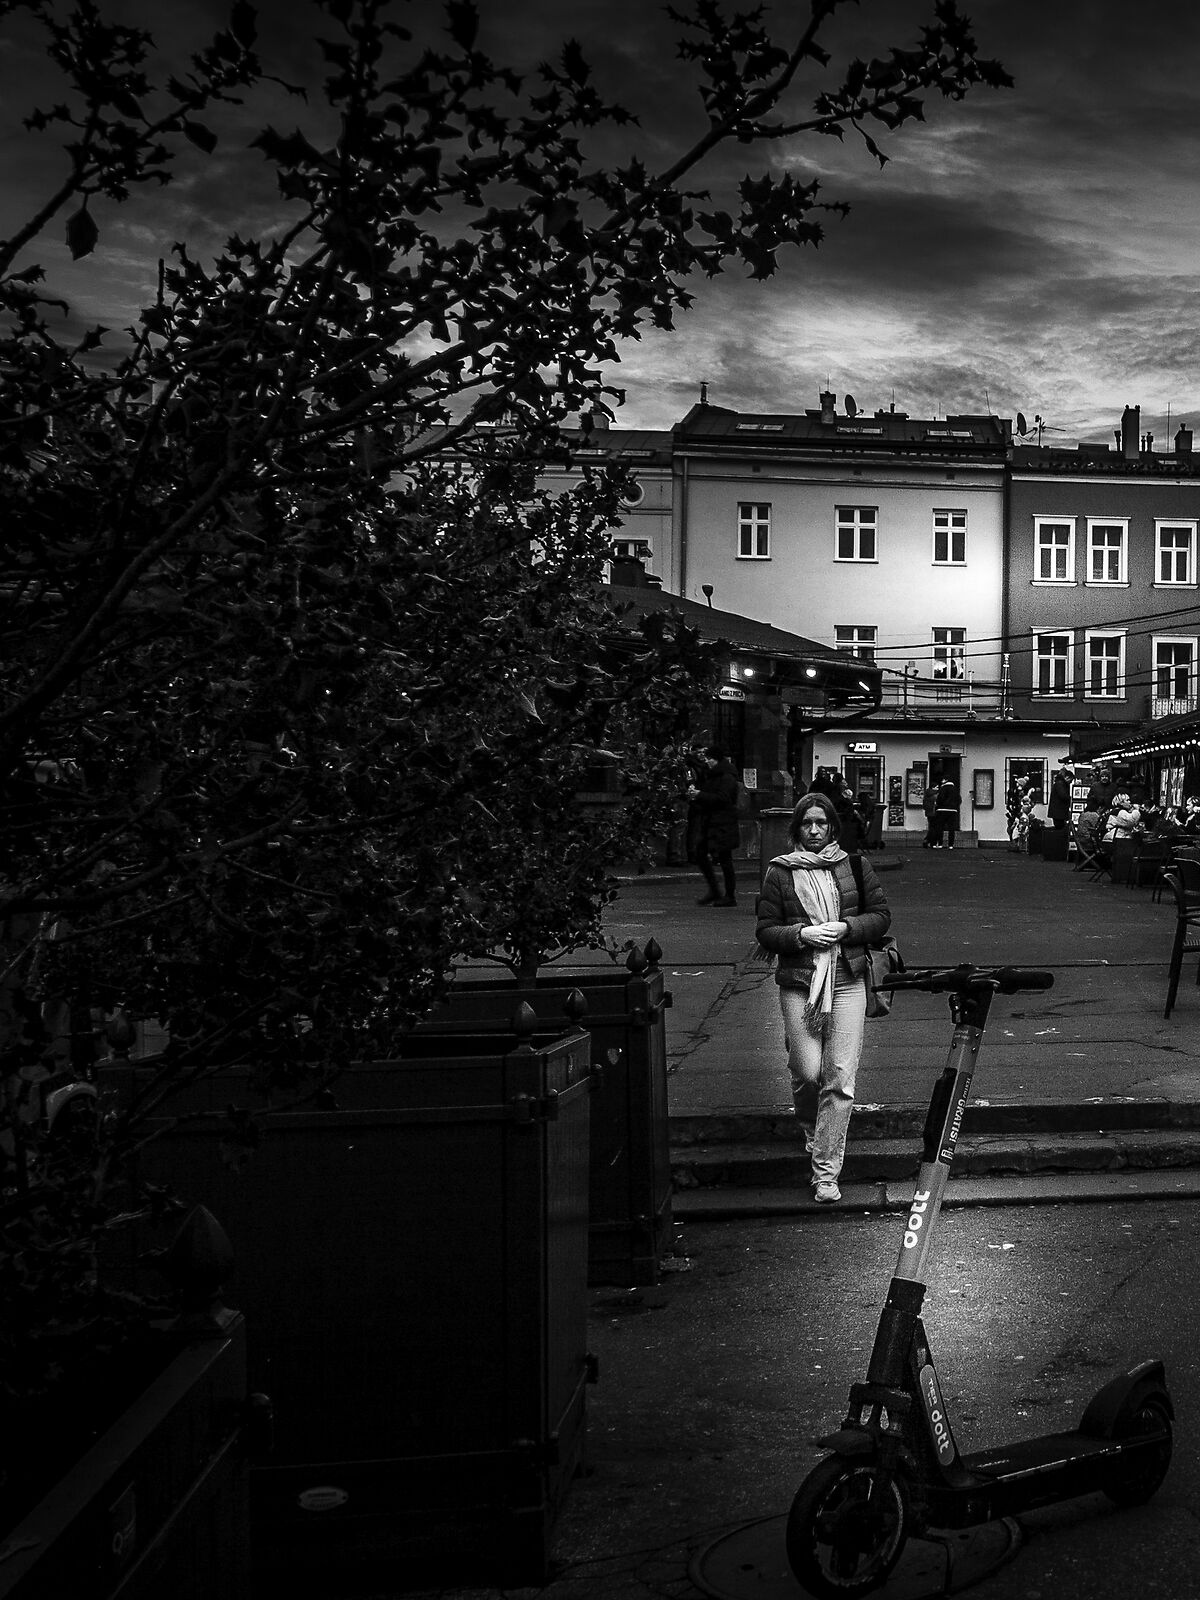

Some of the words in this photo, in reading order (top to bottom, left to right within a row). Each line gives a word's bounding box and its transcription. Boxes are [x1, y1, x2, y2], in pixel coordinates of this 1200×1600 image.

[949, 1098, 966, 1143] GRATIS!
[903, 1190, 931, 1249] dott
[931, 1409, 950, 1454] dott
